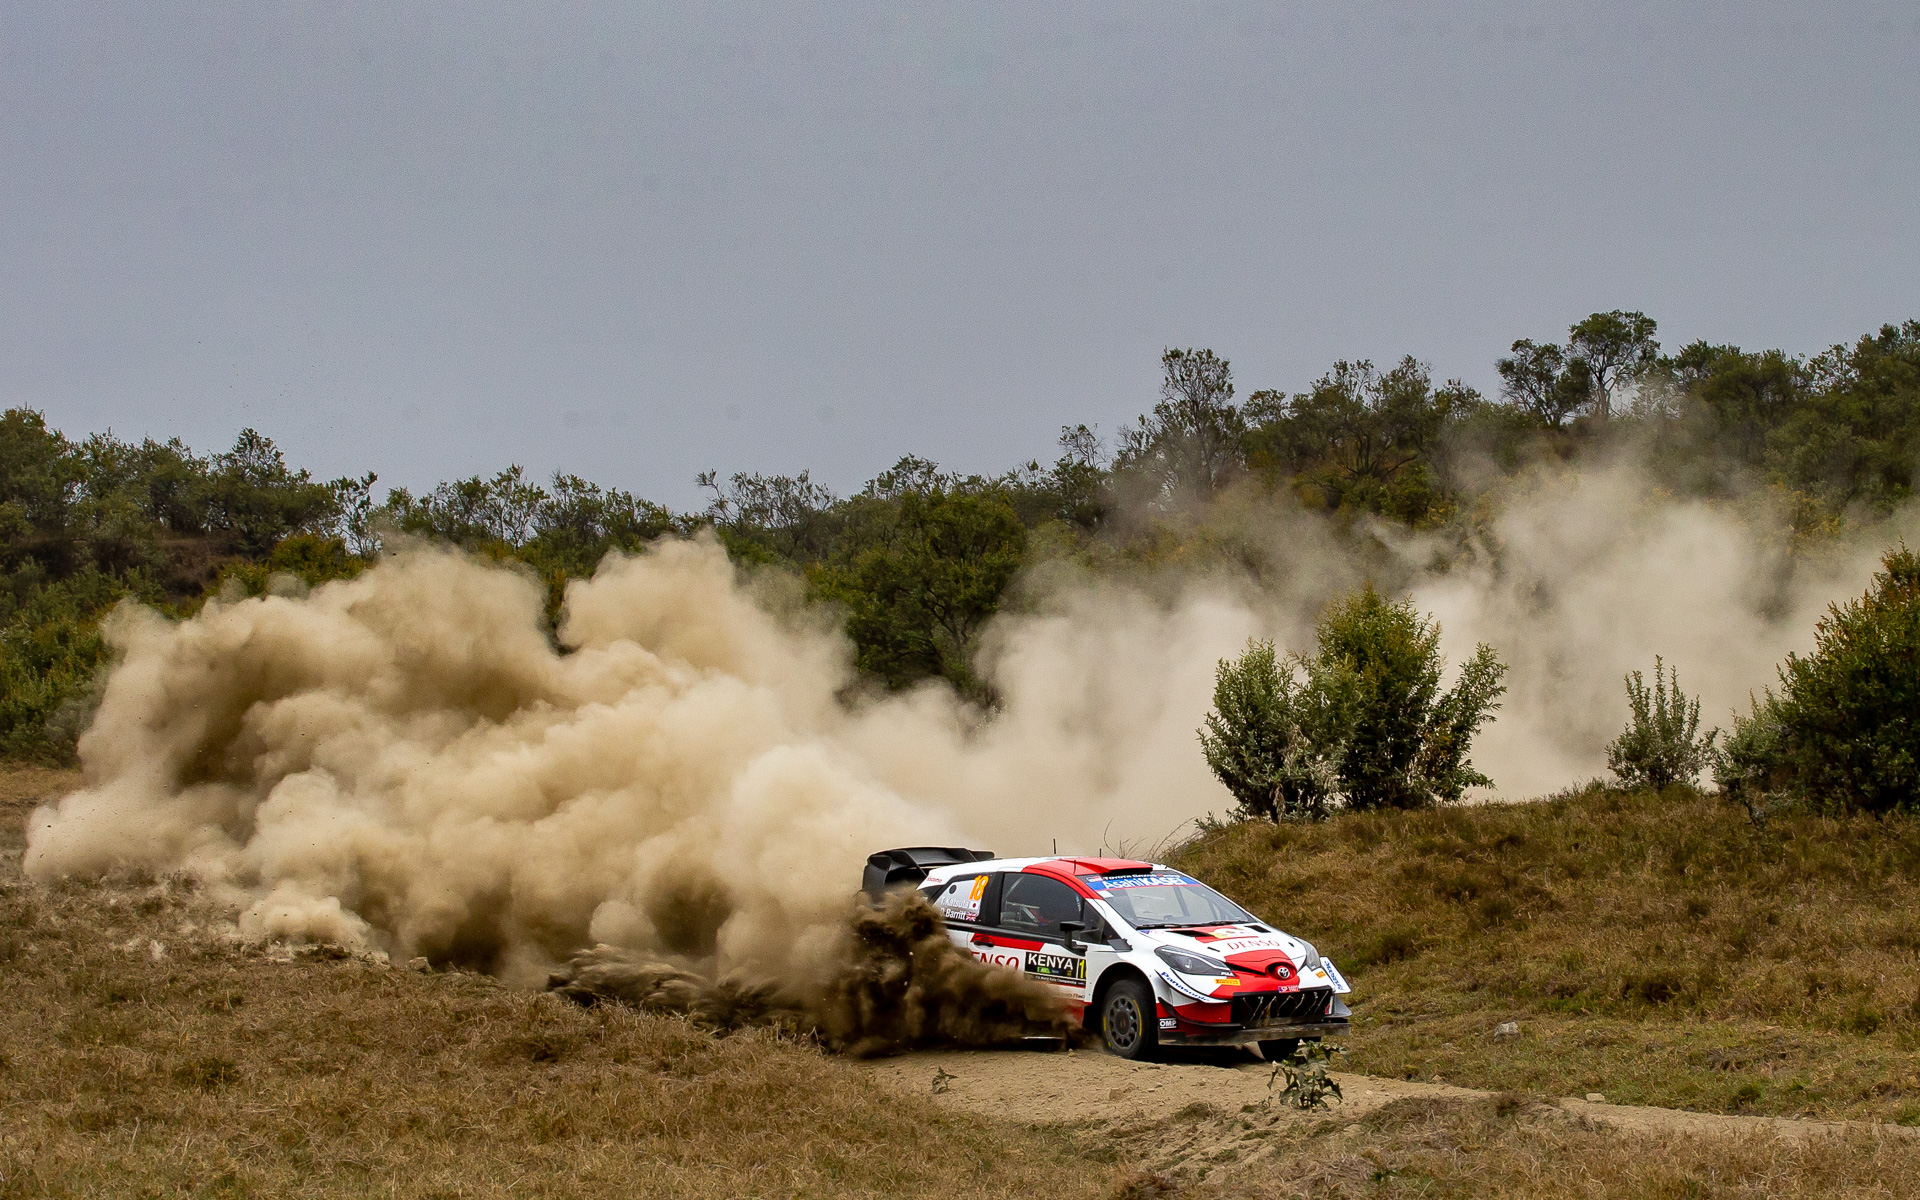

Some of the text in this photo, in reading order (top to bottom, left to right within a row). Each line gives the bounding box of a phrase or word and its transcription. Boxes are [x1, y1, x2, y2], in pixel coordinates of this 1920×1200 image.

[969, 875, 989, 901] 18
[946, 909, 966, 920] Barritt
[1227, 940, 1280, 950] DENSO
[1028, 952, 1073, 970] KENYA
[1160, 971, 1210, 1002] Panasonic
